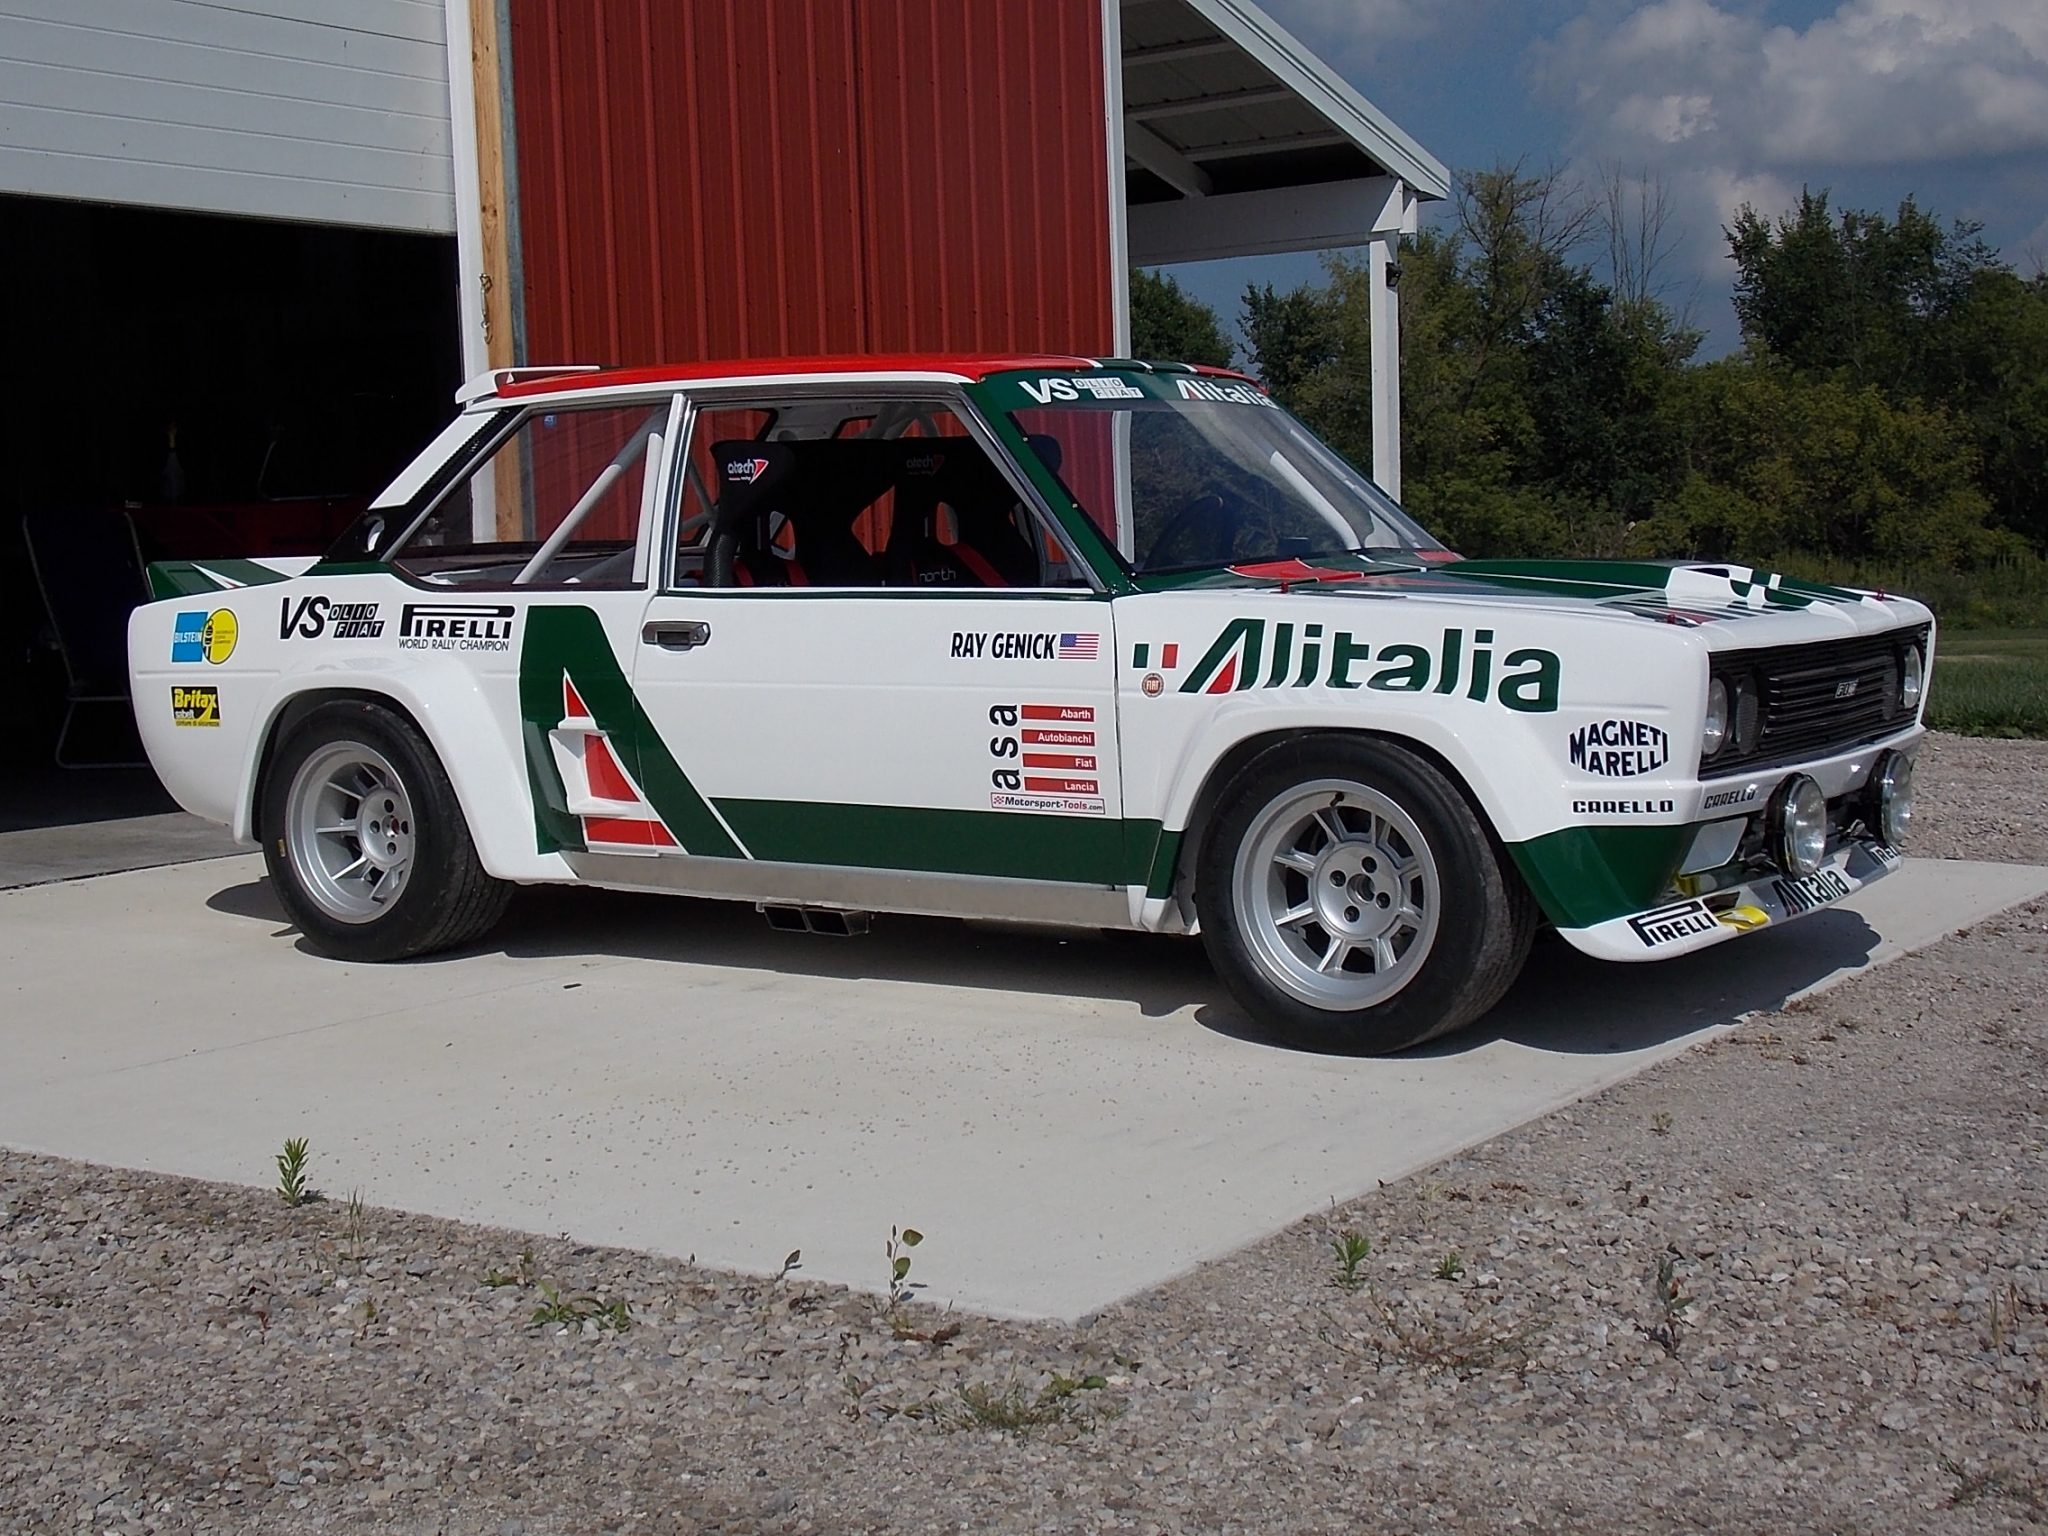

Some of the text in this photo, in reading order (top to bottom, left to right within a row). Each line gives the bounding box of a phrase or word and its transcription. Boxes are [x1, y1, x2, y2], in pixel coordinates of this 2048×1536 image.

[1018, 378, 1080, 404] VS
[1074, 377, 1123, 389] OLIO
[1095, 388, 1140, 398] FIAT
[1176, 380, 1280, 409] Alitalia
[280, 596, 330, 640] VS
[329, 604, 377, 619] OLIO
[400, 604, 515, 639] PIRELLI
[335, 622, 383, 637] FIAT
[399, 638, 509, 651] WORLD RALLY CHAMPION
[950, 632, 1057, 659] RAY GENICK
[1179, 617, 1561, 712] Alitalia
[174, 688, 218, 708] Britax
[1061, 709, 1091, 719] Abarth
[1038, 732, 1092, 744] Autobianchi
[1569, 720, 1669, 752] MAGNETI
[1075, 758, 1093, 768] Fiat
[1569, 746, 1669, 776] MARELLI
[1064, 782, 1095, 791] Lancia
[1573, 800, 1673, 813] CARELLO
[1704, 789, 1756, 809] CARELLO
[1626, 901, 1718, 947] PIRELLI
